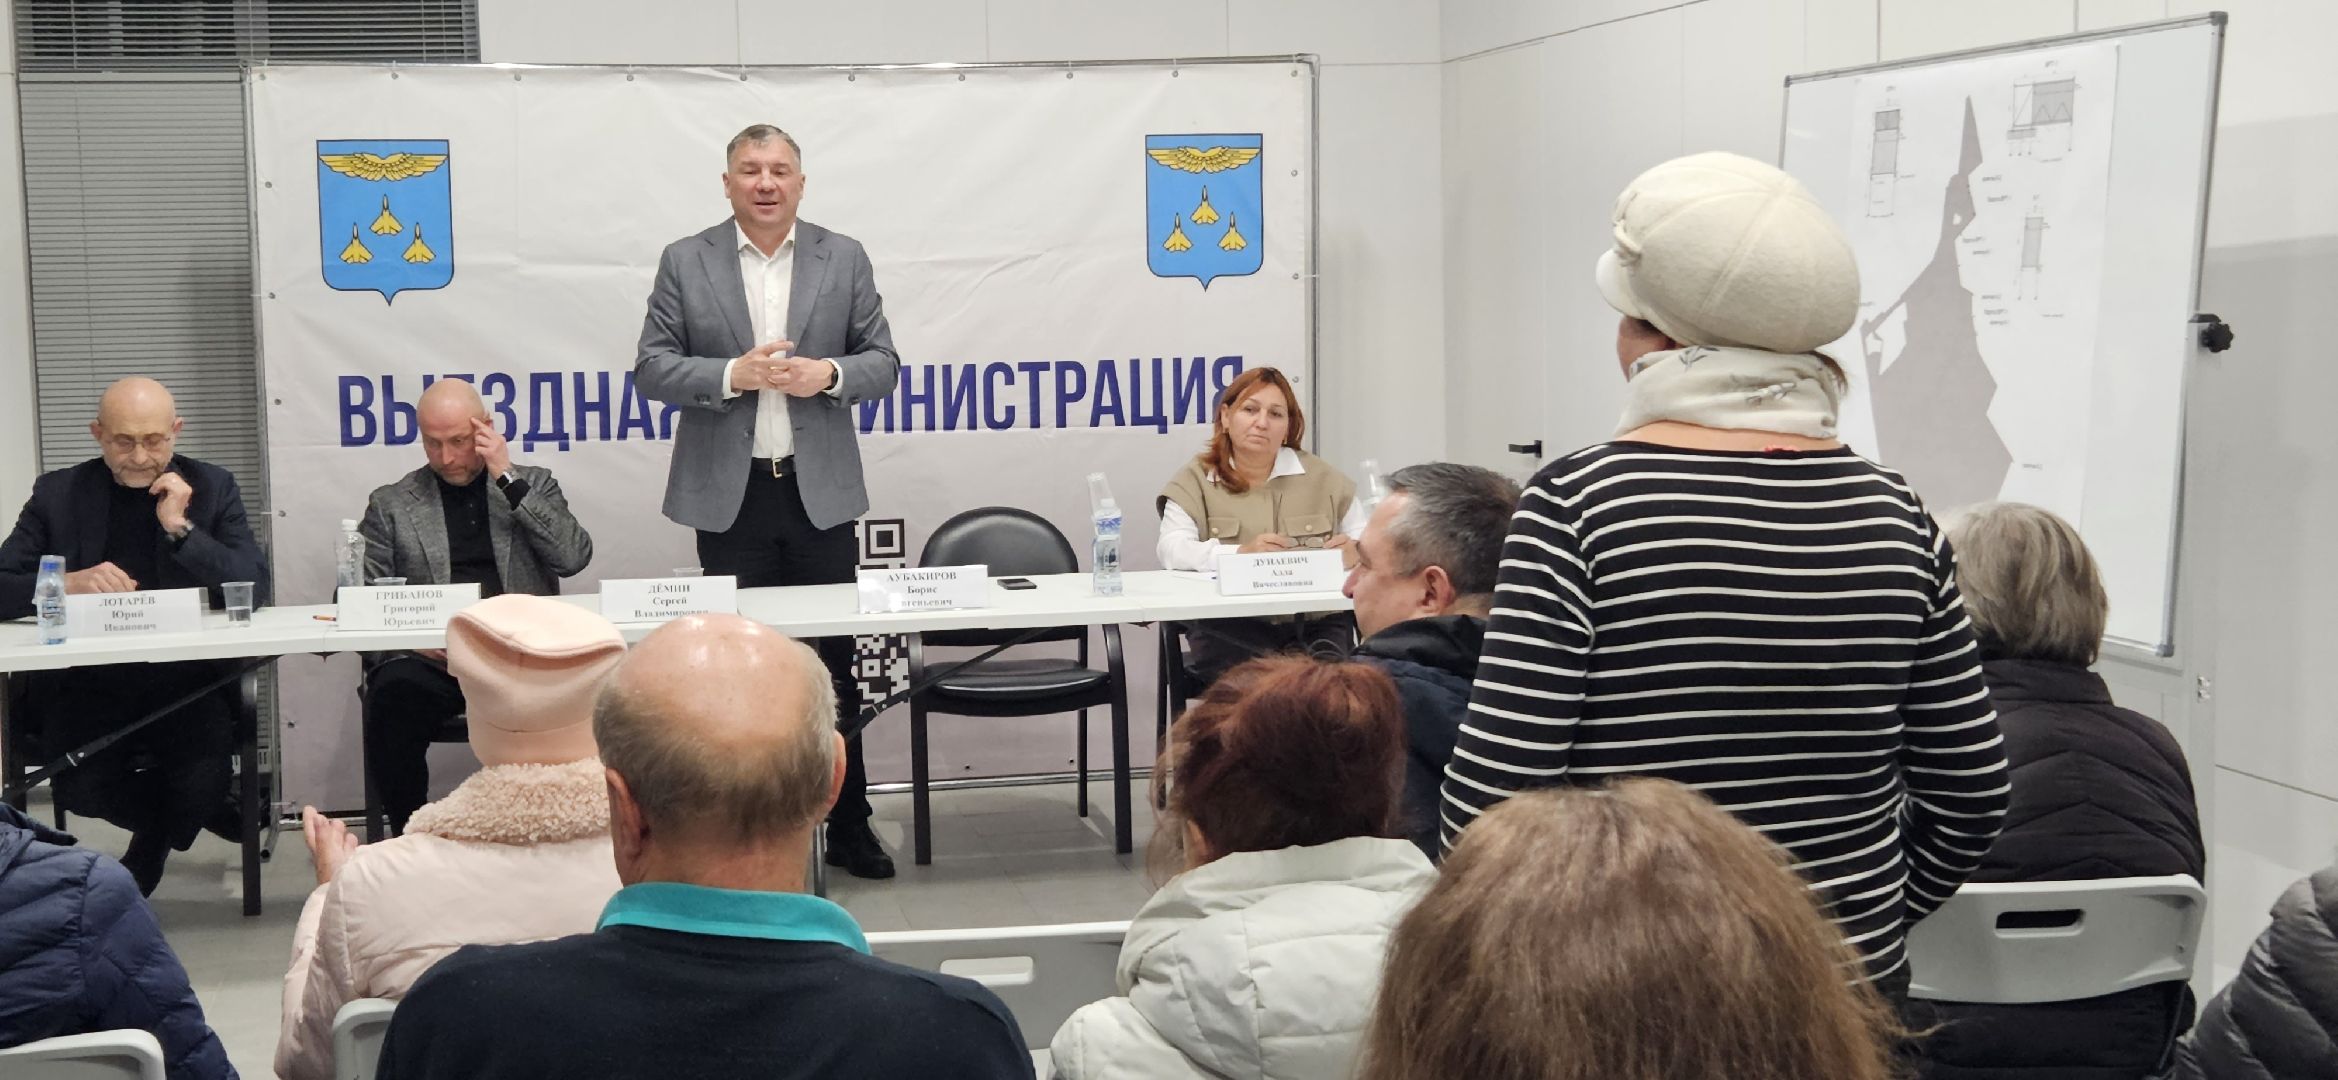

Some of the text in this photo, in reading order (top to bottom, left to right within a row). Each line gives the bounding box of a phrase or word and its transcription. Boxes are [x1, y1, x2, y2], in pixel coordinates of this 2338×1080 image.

[338, 370, 682, 452] ВЫЗДНА
[887, 571, 957, 582] АУБАКИРОВ
[648, 583, 691, 594] ДЁМИН
[906, 585, 938, 596] Борис
[98, 594, 156, 607] ЛОТАРЁВ
[376, 589, 444, 601] ГРИБАНОВ
[652, 597, 688, 607] Сергей
[900, 599, 953, 608] вгеньевич
[383, 603, 436, 615] Григорий
[112, 609, 145, 621] Юрий
[104, 622, 157, 632] Иванович
[383, 617, 436, 628] Юрьевич
